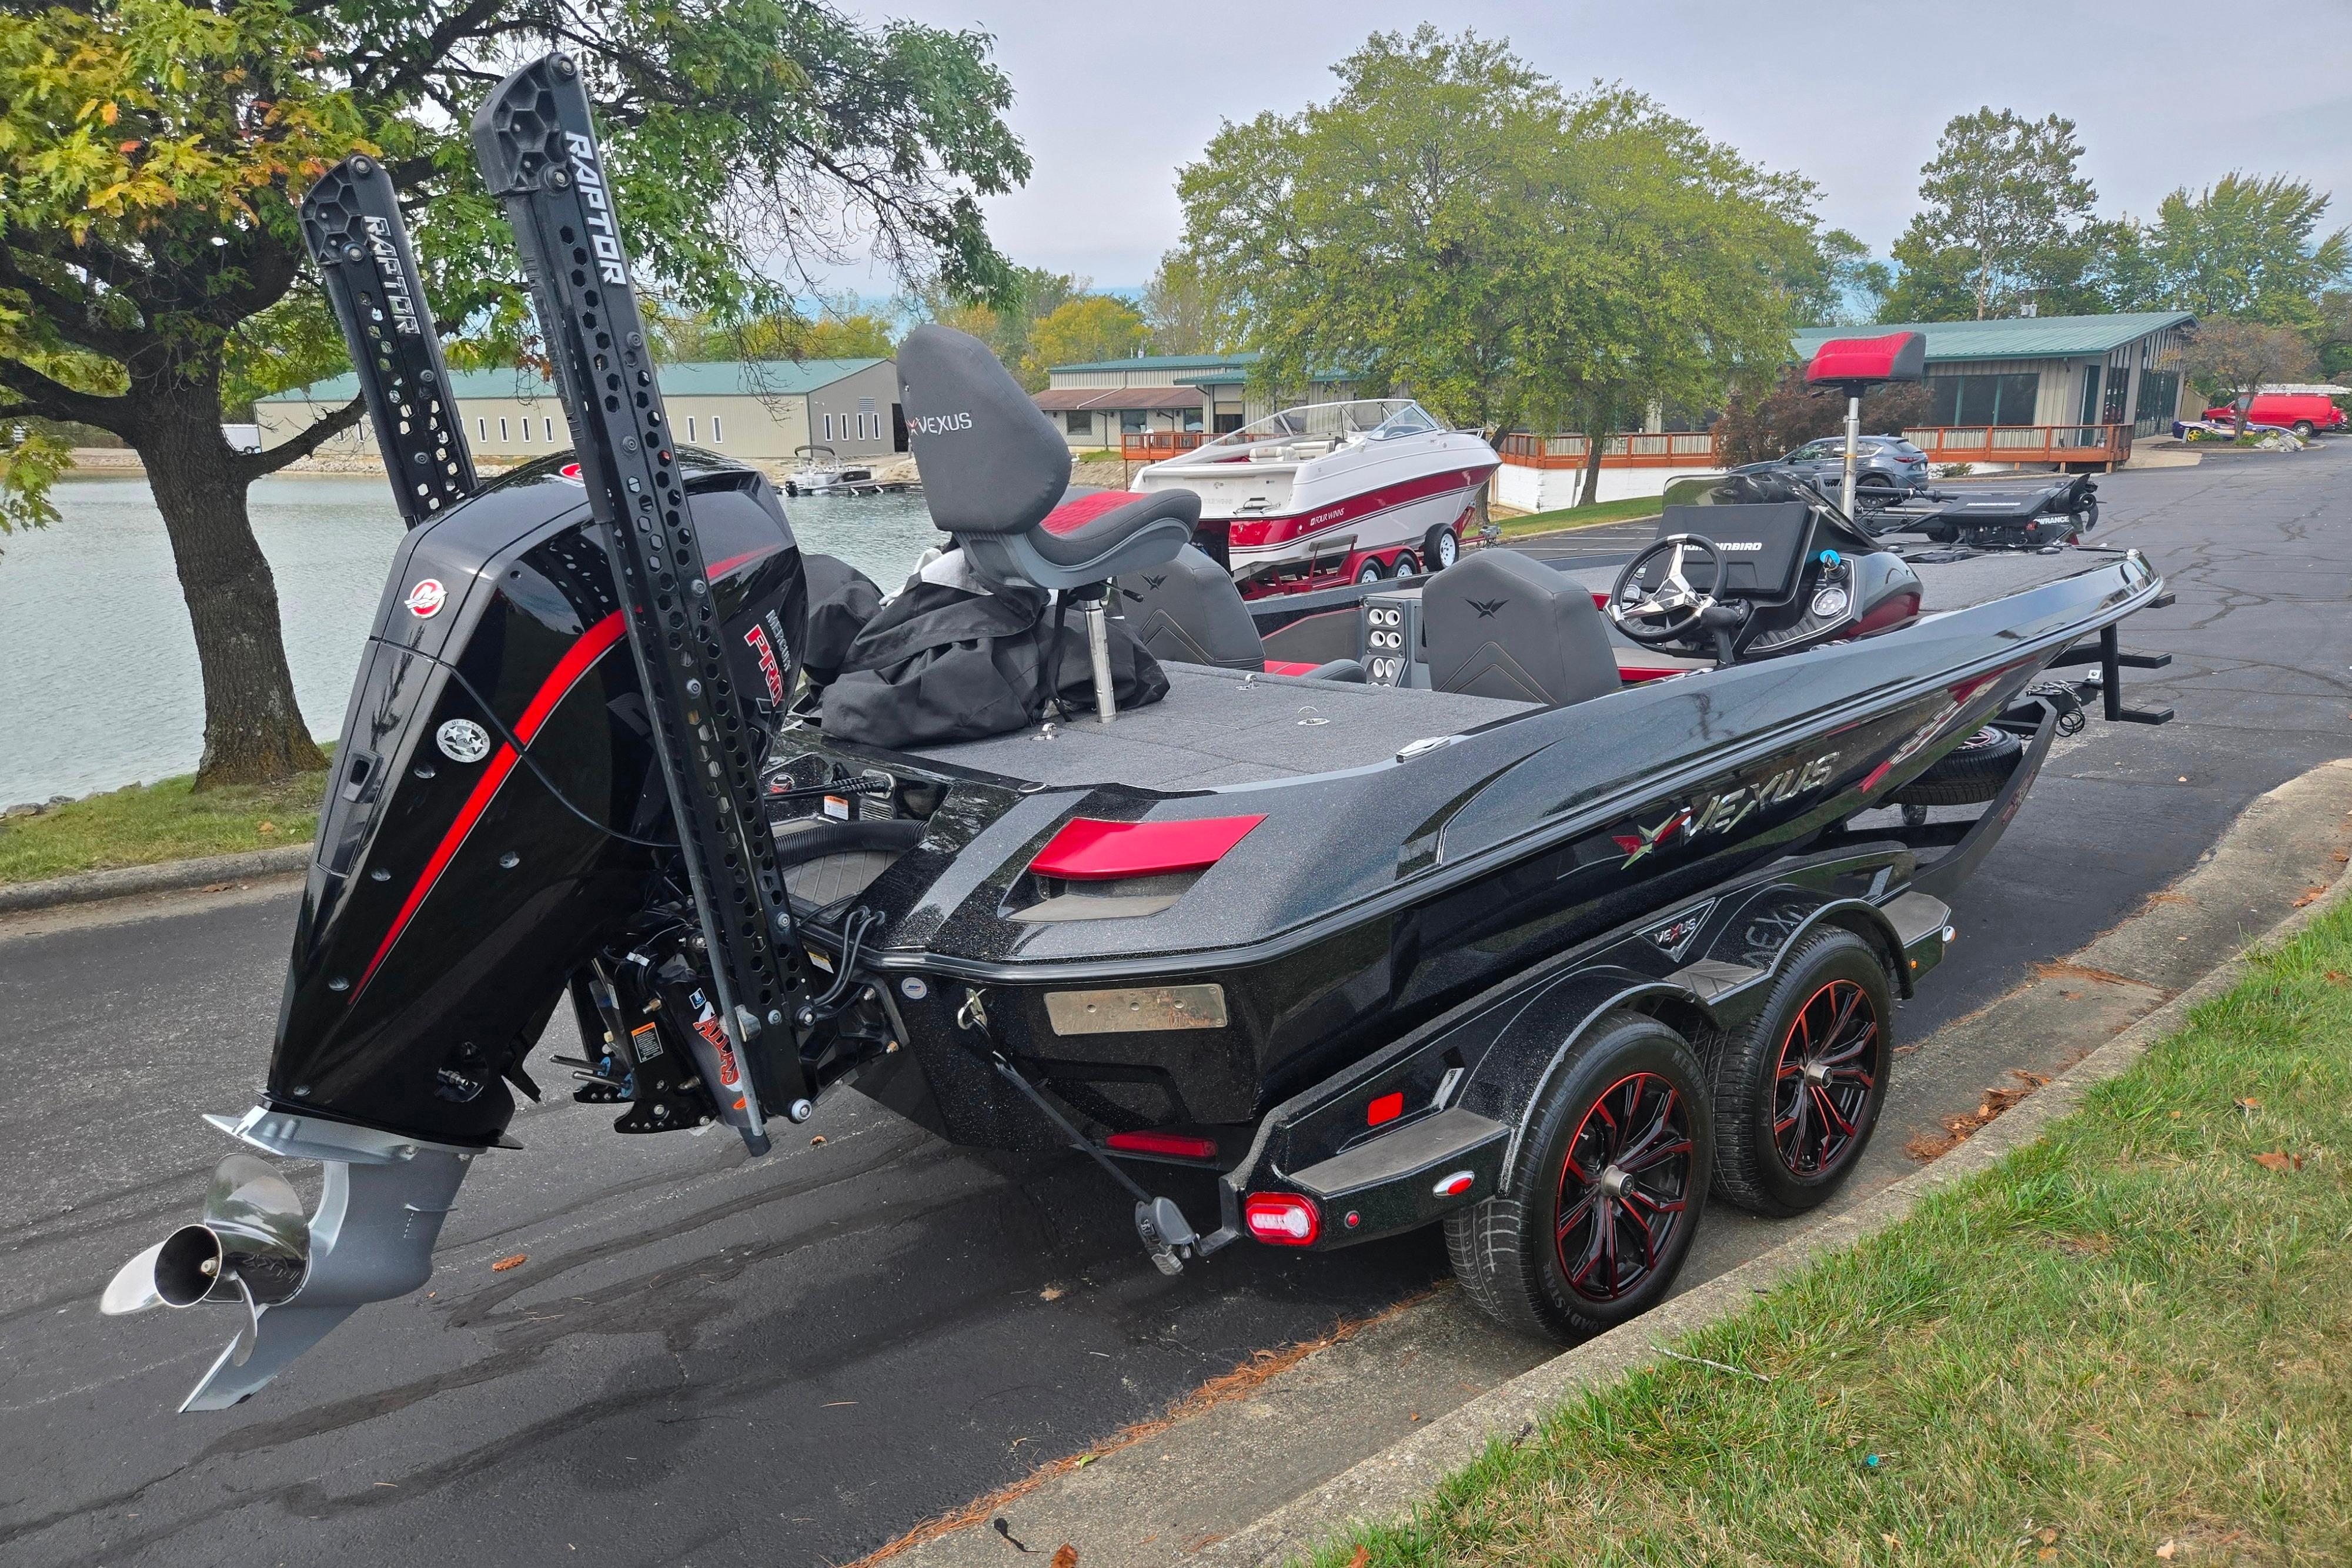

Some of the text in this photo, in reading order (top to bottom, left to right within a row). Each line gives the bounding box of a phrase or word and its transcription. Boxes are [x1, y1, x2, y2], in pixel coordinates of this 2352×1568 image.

[566, 131, 627, 285] RAPTOR
[364, 216, 420, 335] RAPTOR
[918, 412, 973, 435] VEXUS
[1315, 507, 1345, 524] FOUR WINNS
[744, 624, 783, 707] PRO
[766, 609, 791, 671] MERCURY
[1679, 751, 1840, 847] VEXUS
[1654, 918, 1696, 945] VEXUS
